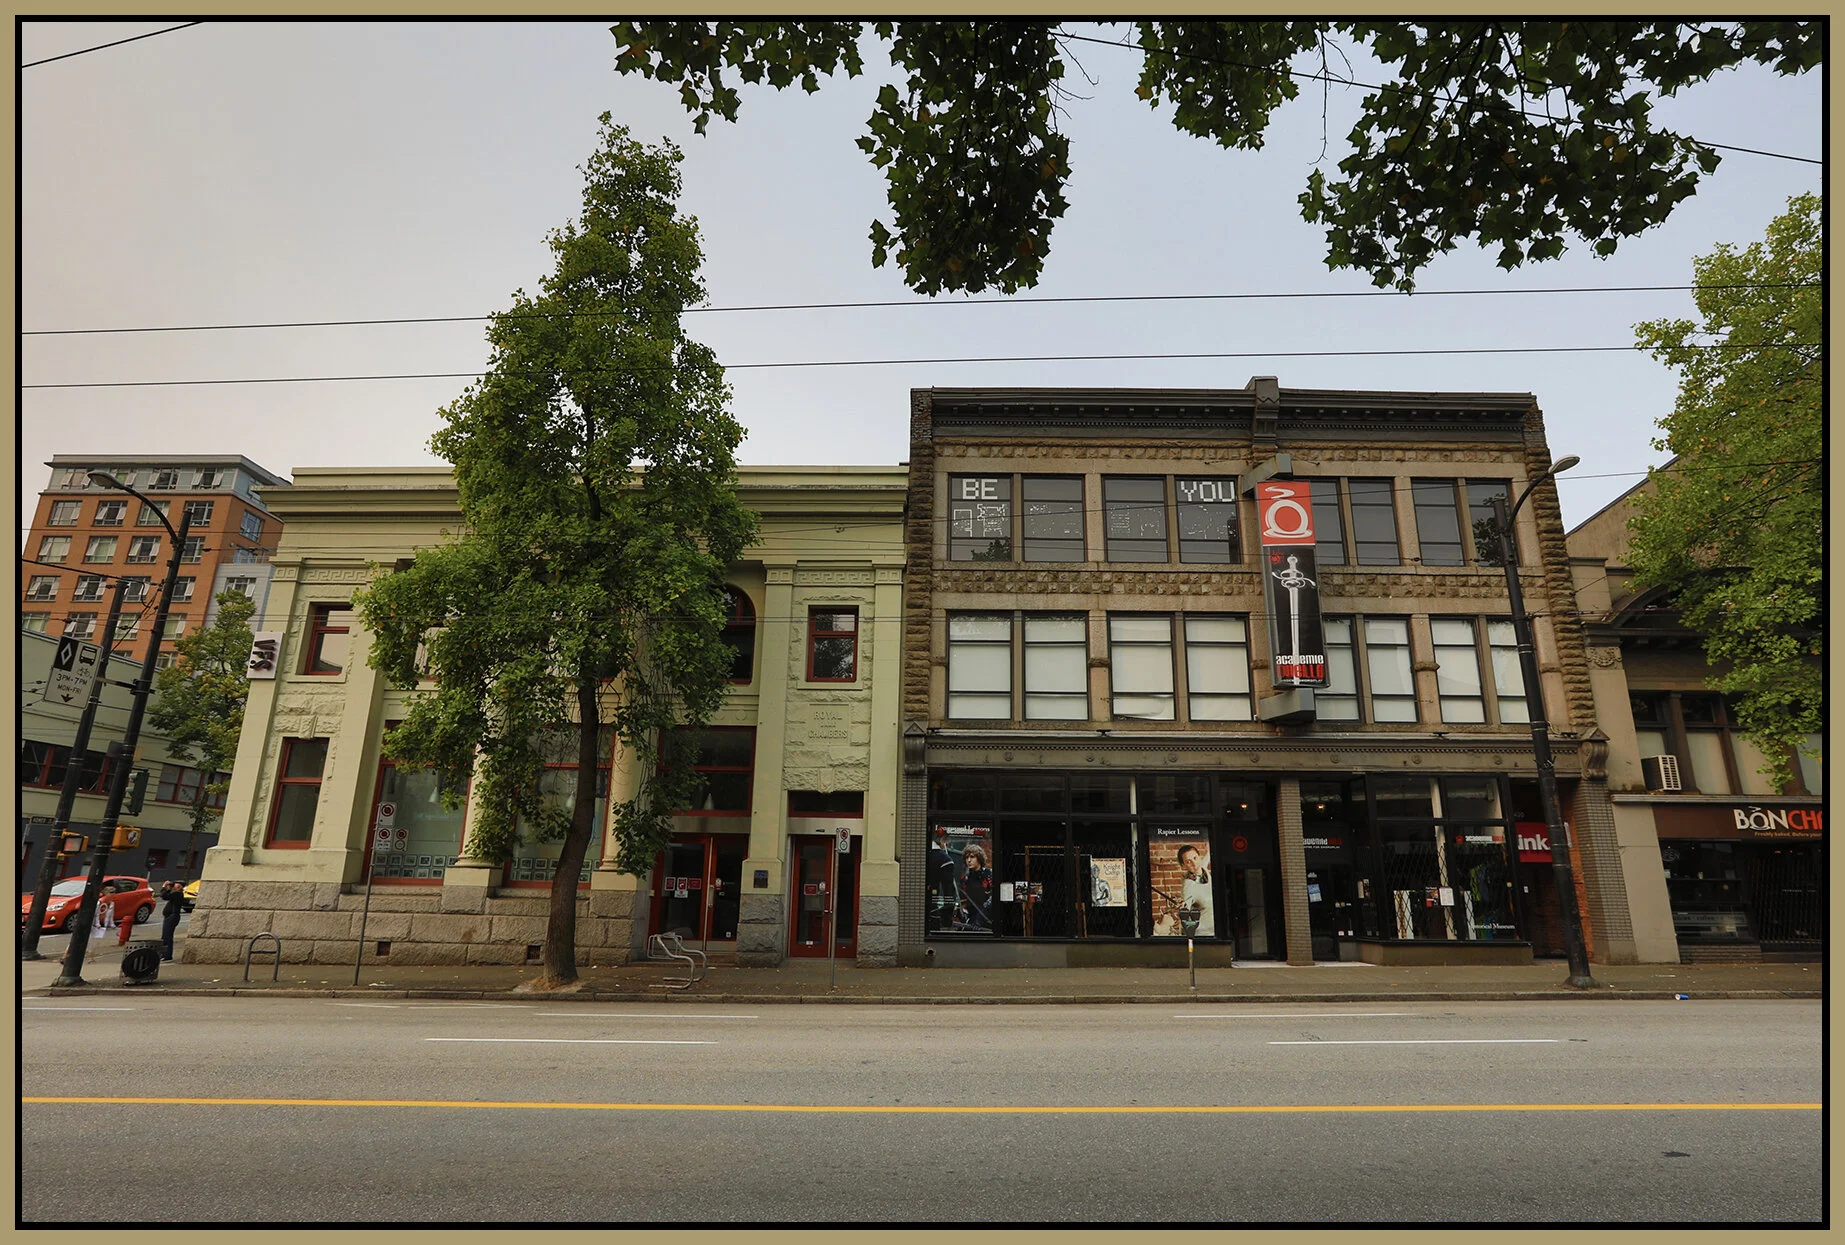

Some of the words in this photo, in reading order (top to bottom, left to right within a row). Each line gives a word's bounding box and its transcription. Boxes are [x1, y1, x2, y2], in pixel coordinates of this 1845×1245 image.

[962, 478, 998, 500] BE
[1180, 480, 1236, 502] YOU
[249, 639, 276, 671] VFS
[1275, 654, 1325, 664] acaemie
[1157, 828, 1176, 837] Rapier
